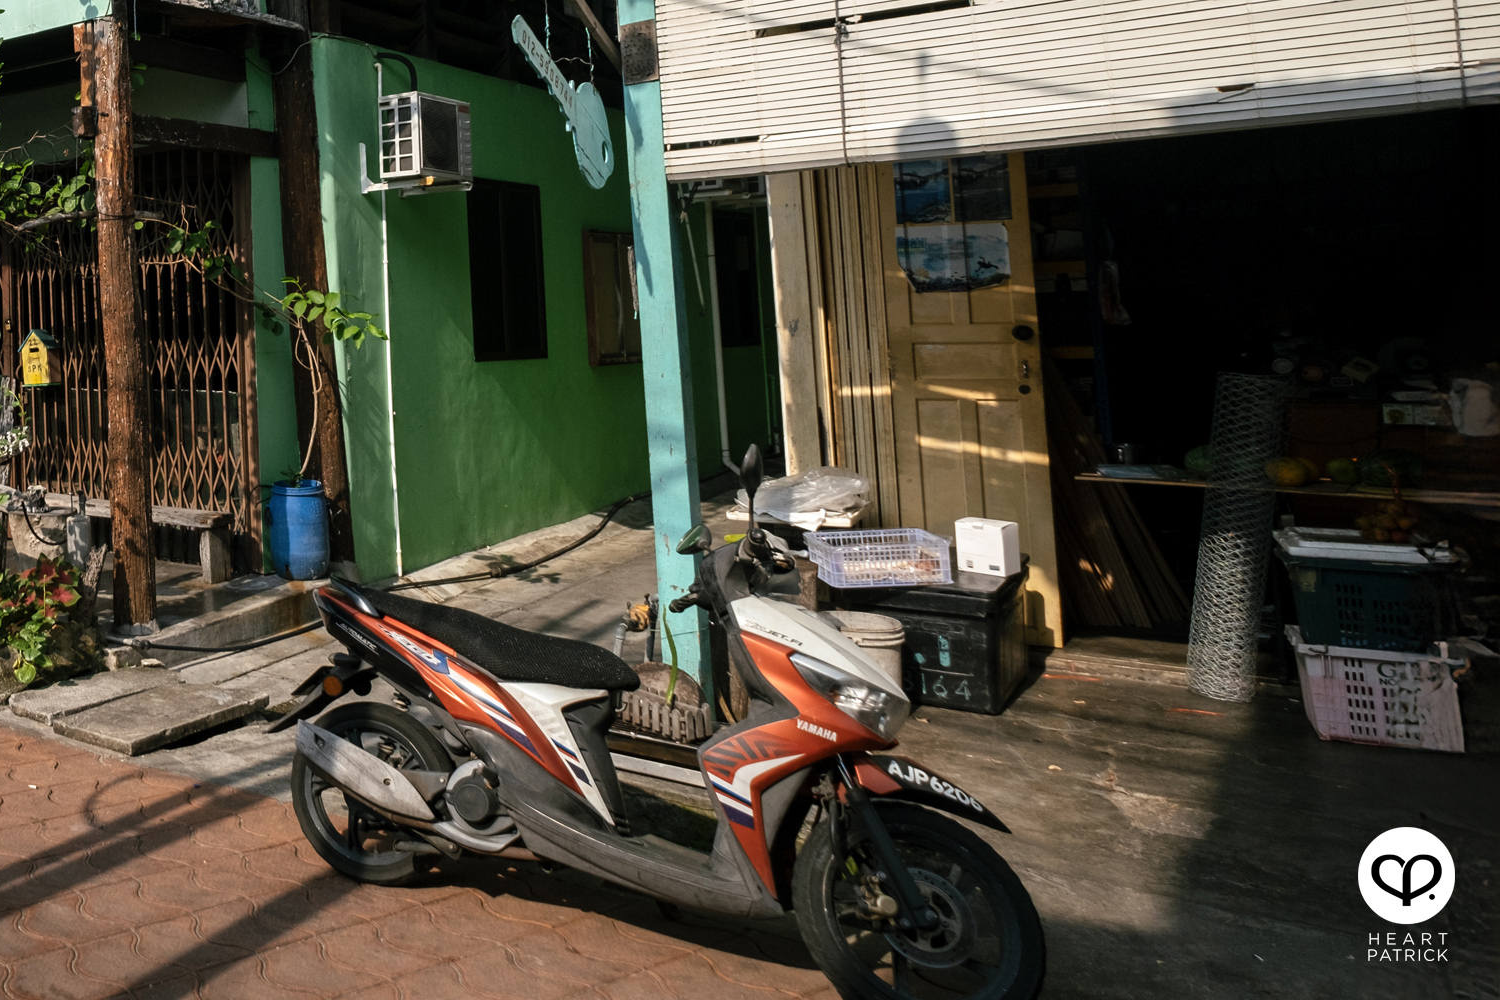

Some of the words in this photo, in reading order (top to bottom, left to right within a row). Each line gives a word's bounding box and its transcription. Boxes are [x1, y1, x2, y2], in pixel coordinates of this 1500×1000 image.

[522, 29, 573, 108] 012-5908744
[340, 623, 378, 650] AUTOMATIC
[796, 718, 838, 742] YAMAHA
